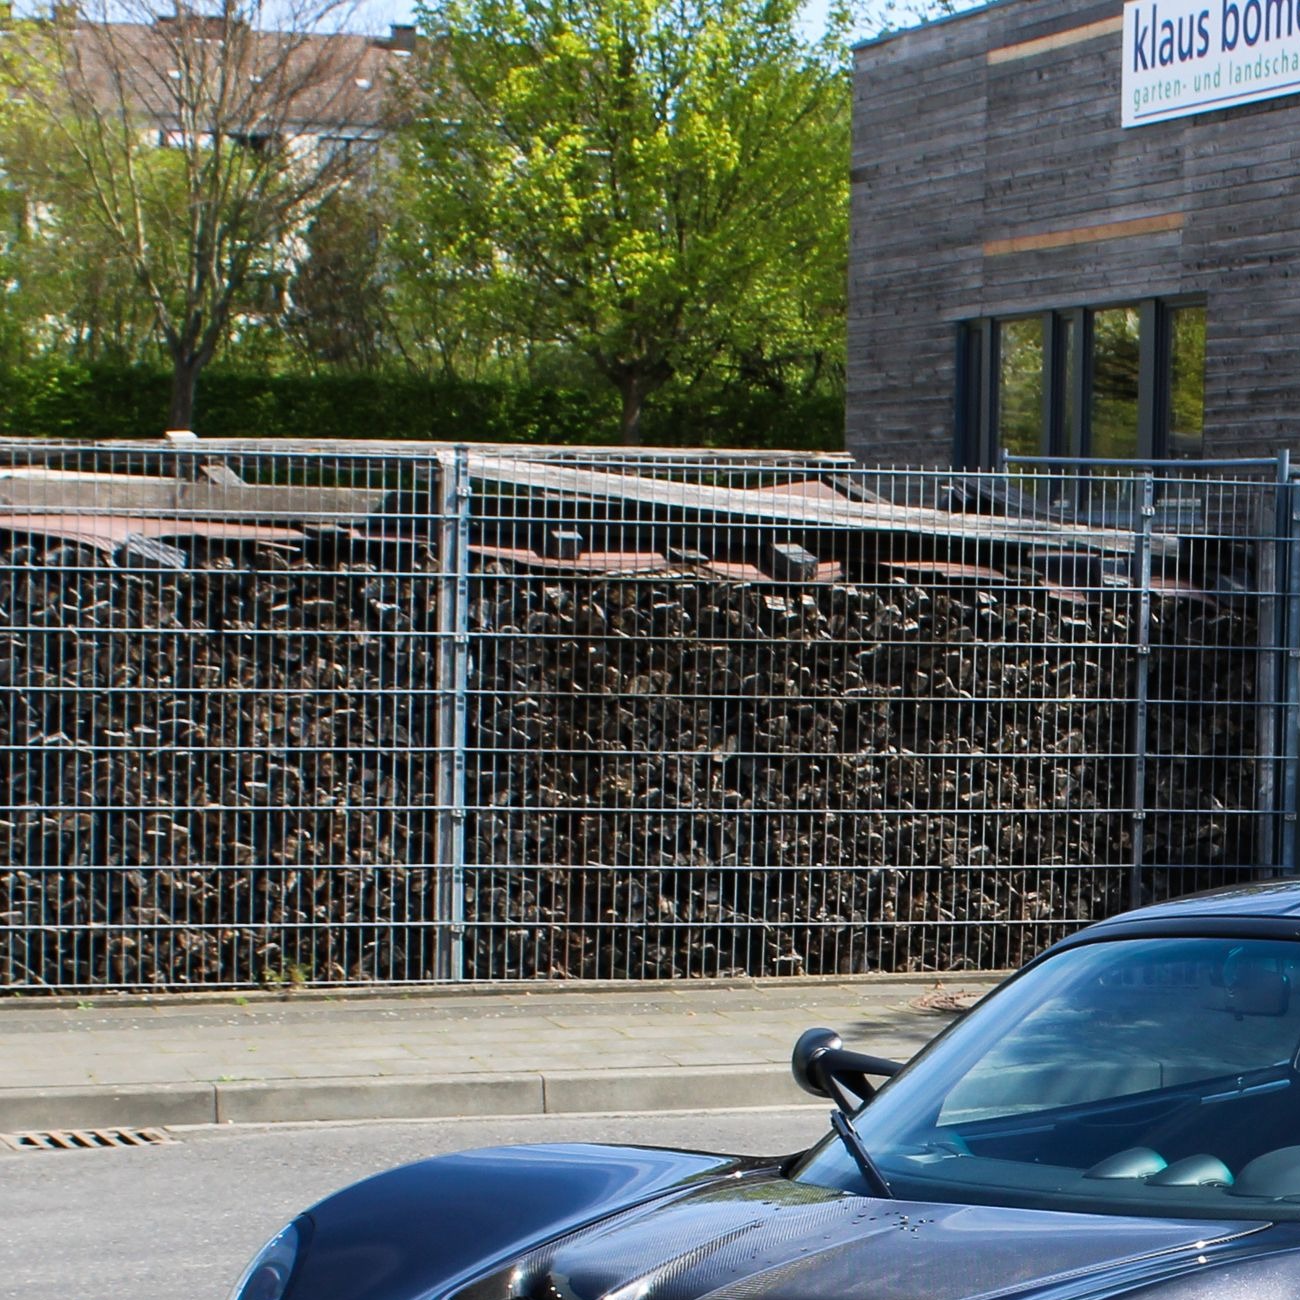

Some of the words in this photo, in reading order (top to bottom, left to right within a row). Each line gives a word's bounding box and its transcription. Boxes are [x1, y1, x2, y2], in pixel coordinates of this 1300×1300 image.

[1133, 3, 1210, 73] klaus
[1133, 78, 1187, 112] garten-
[1194, 63, 1221, 92] und
